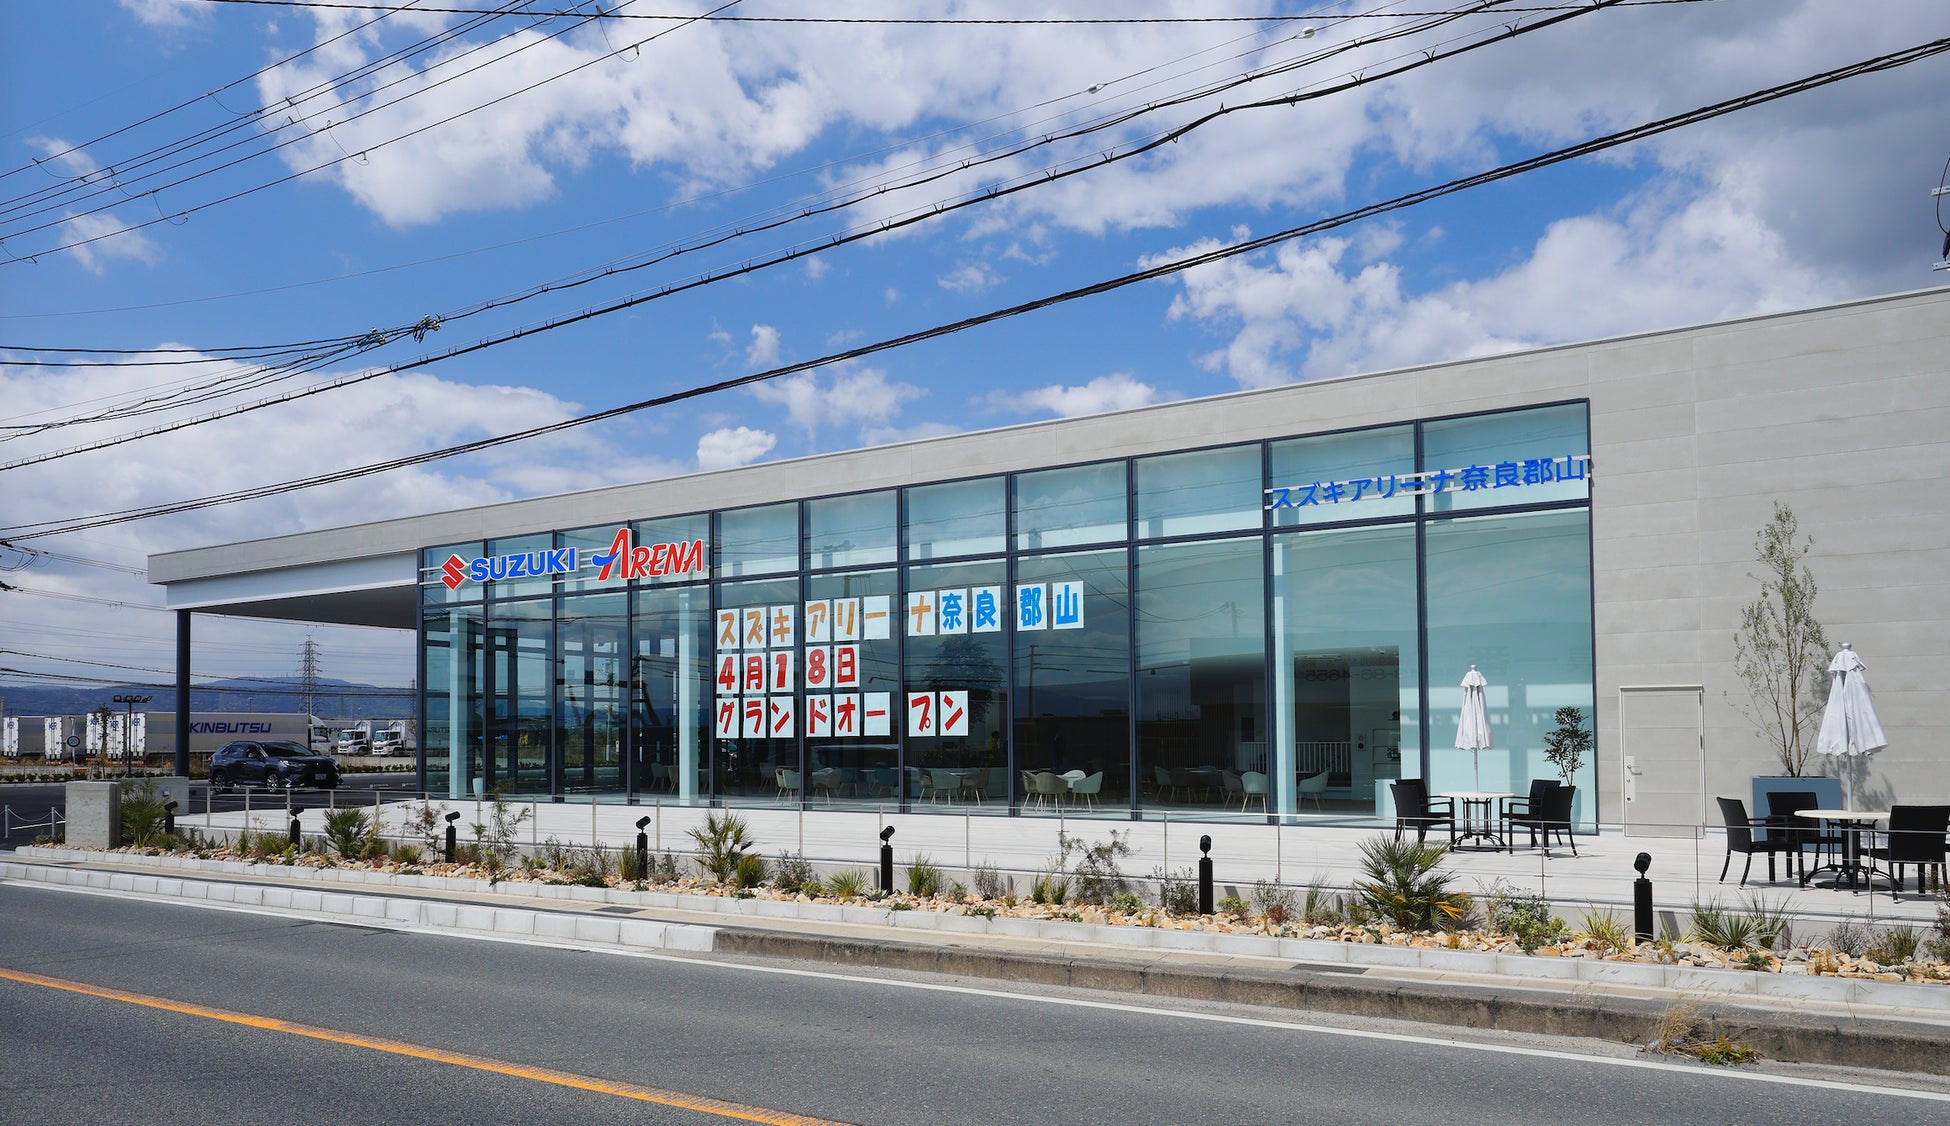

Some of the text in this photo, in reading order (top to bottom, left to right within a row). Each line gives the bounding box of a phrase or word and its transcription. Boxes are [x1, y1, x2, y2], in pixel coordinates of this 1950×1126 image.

[1271, 455, 1585, 509] スズキアリーナ奈良郡山
[470, 528, 704, 582] SUZUKI ARENA
[718, 647, 856, 691] 4月18日
[189, 722, 272, 734] KINBUTSU
[719, 694, 964, 734] グランドオープン
